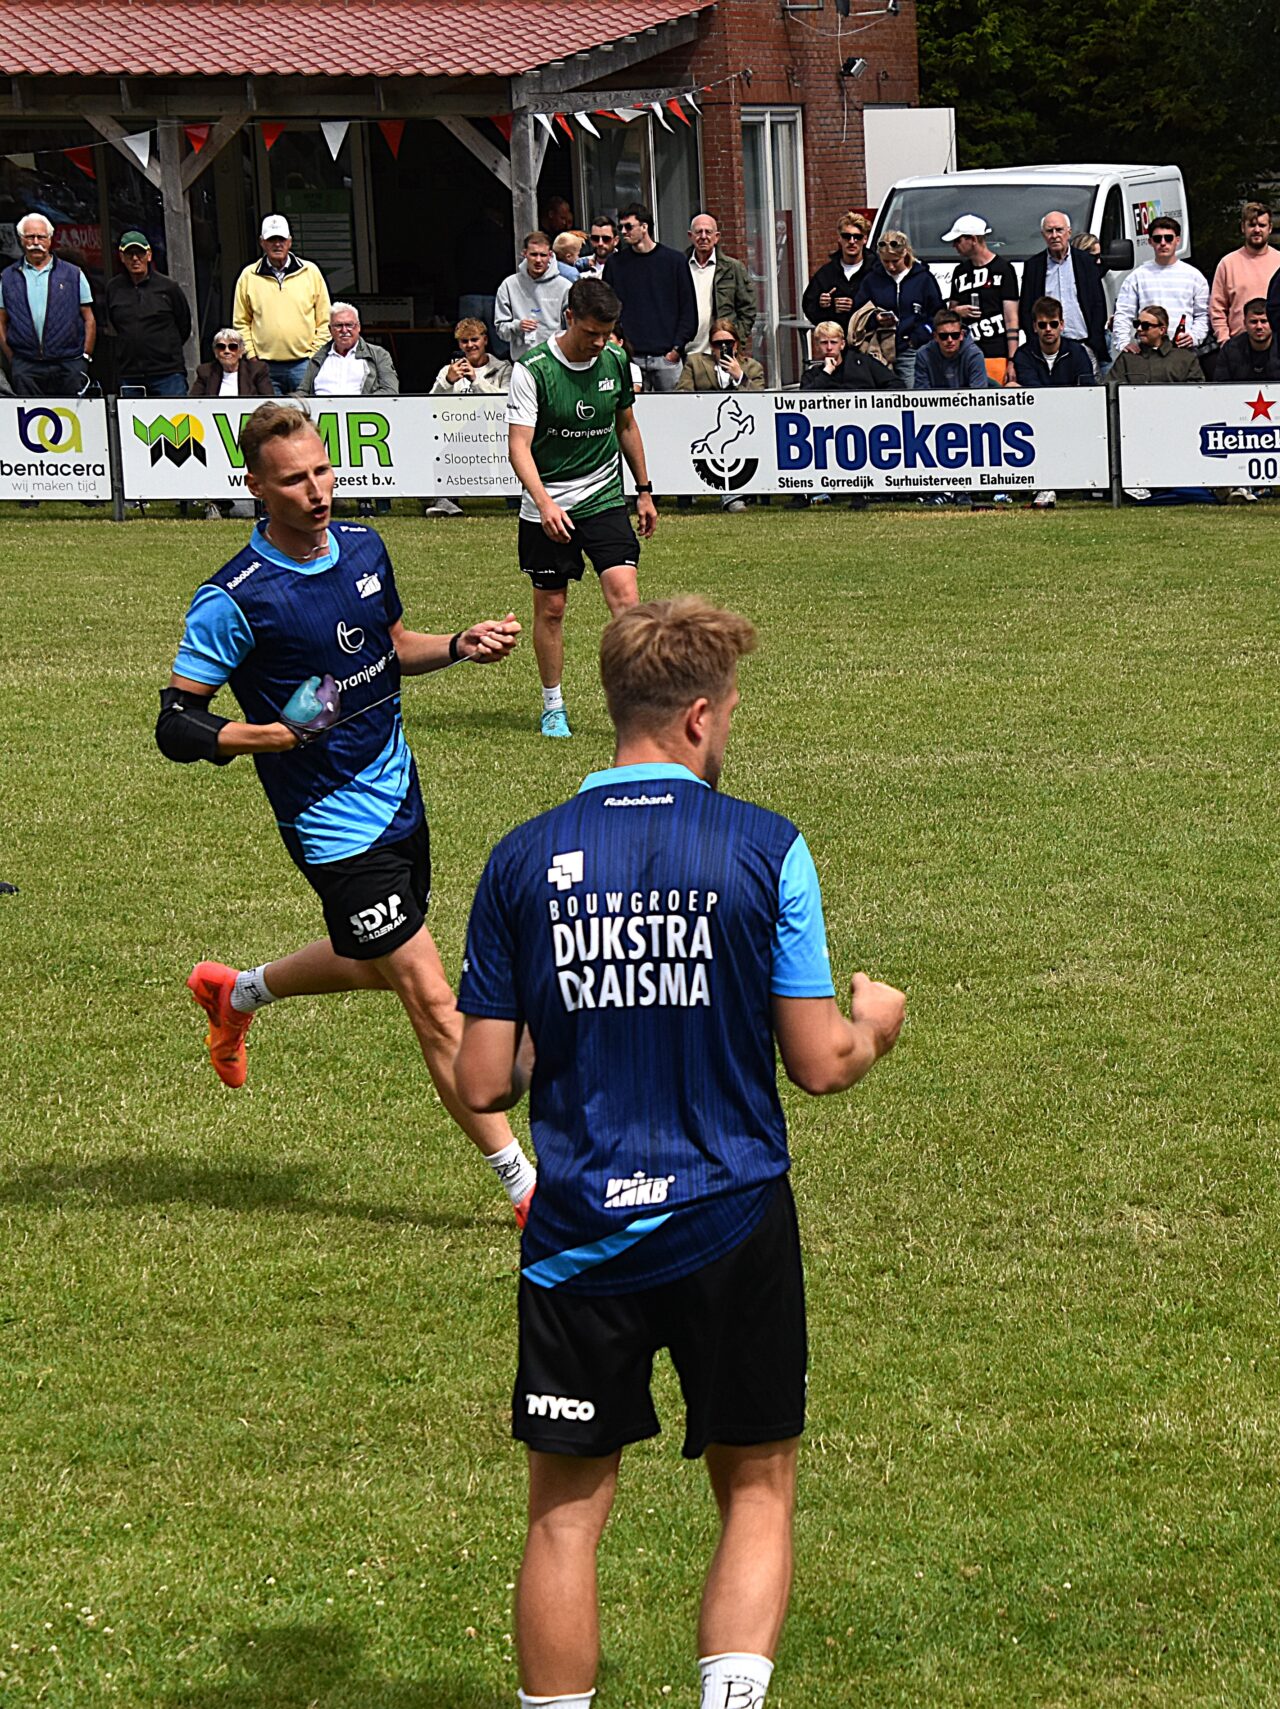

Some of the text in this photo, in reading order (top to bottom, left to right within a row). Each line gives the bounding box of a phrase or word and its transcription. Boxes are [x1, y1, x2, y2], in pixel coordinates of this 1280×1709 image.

[774, 392, 1035, 412] Uw partner in landbouwmechanisatie
[441, 411, 480, 422] Grond-
[443, 432, 509, 443] Milieutechn
[561, 422, 614, 438] Oranjewou
[775, 410, 1036, 471] Broekens
[0, 460, 105, 476] bentacera
[444, 453, 509, 466] Slooptechn
[1248, 458, 1278, 480] 0.0
[12, 480, 96, 493] wij maken tijd
[372, 474, 396, 486] b.v.
[778, 473, 1035, 490] Stiens Gorredijk Surhuisterveen Elahuizen
[226, 561, 262, 590] Rabobank
[603, 793, 675, 807] Rabobank
[549, 889, 718, 921] BOUWGROEP
[553, 915, 714, 967] DIJKSTRA
[557, 961, 711, 1013] DRAISMA
[525, 1394, 596, 1422] NYCO
